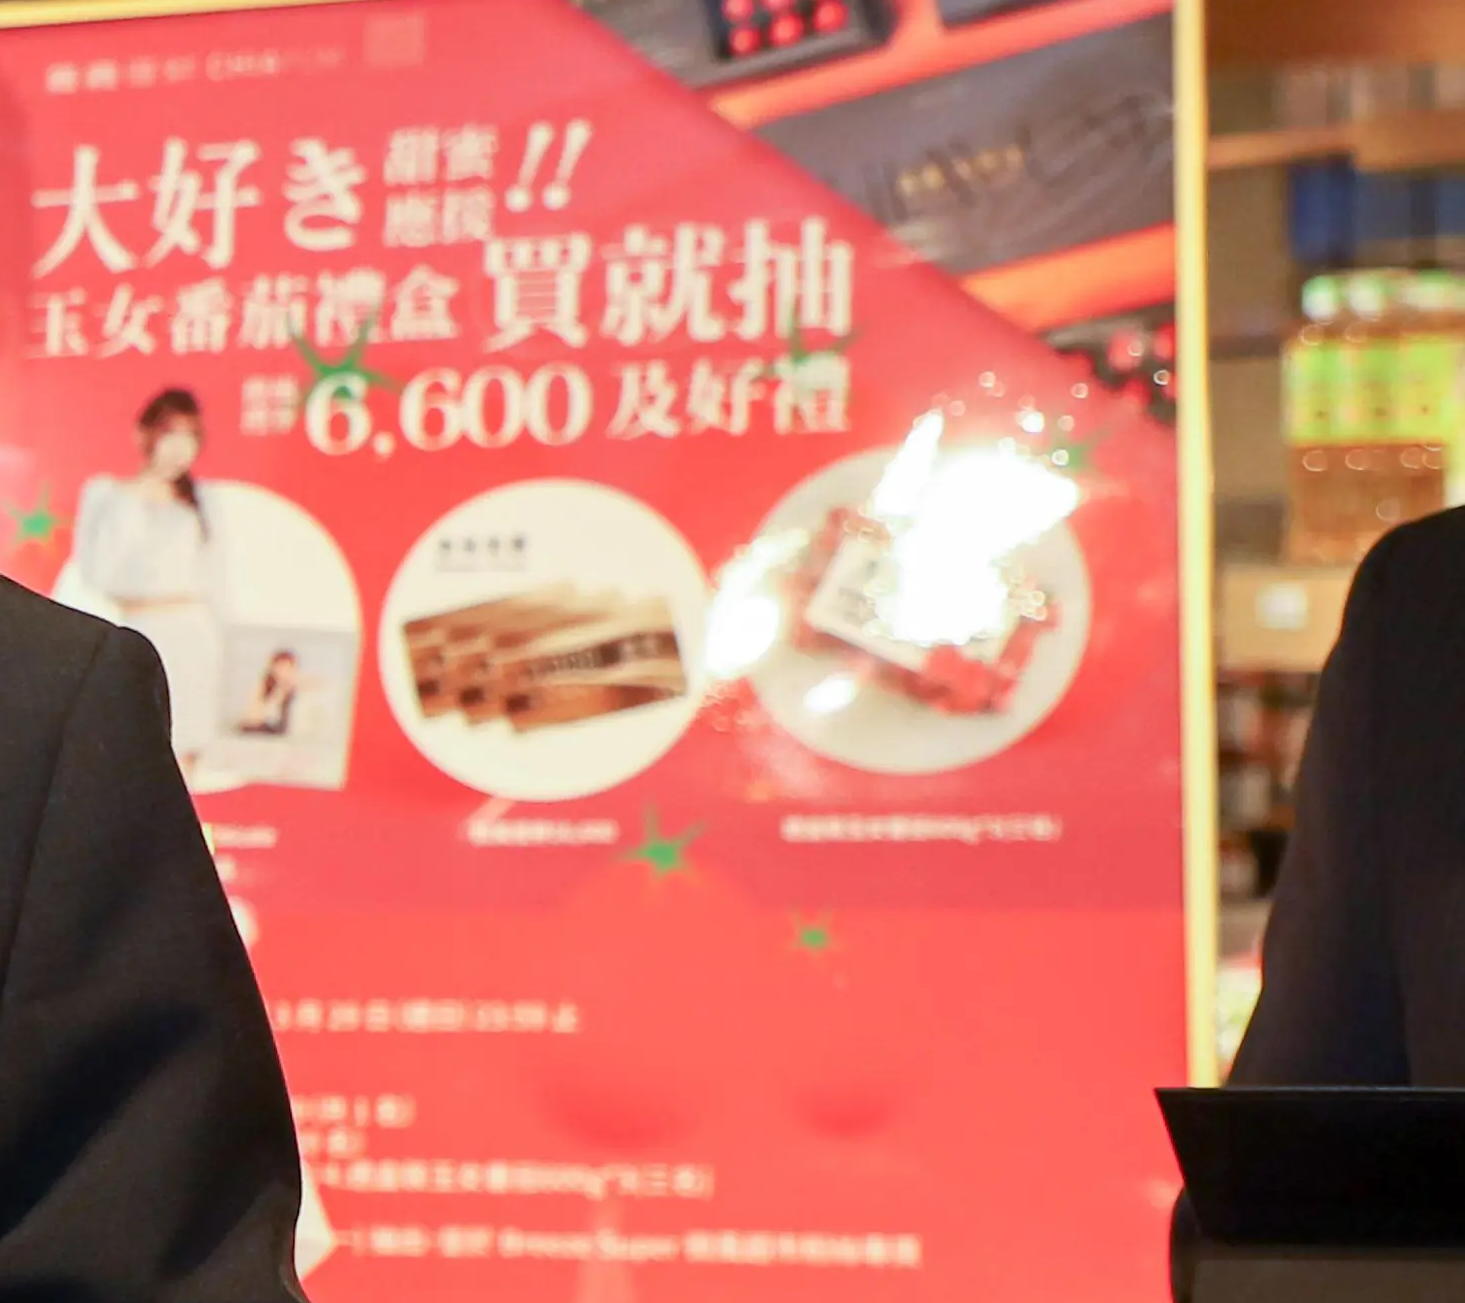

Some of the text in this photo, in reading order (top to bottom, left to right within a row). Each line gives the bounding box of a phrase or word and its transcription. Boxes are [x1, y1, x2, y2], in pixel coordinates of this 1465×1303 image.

[29, 136, 367, 280] 大好き
[482, 216, 855, 353] 買就抽
[304, 363, 595, 463] 6,600
[605, 350, 853, 440] 及好禮
